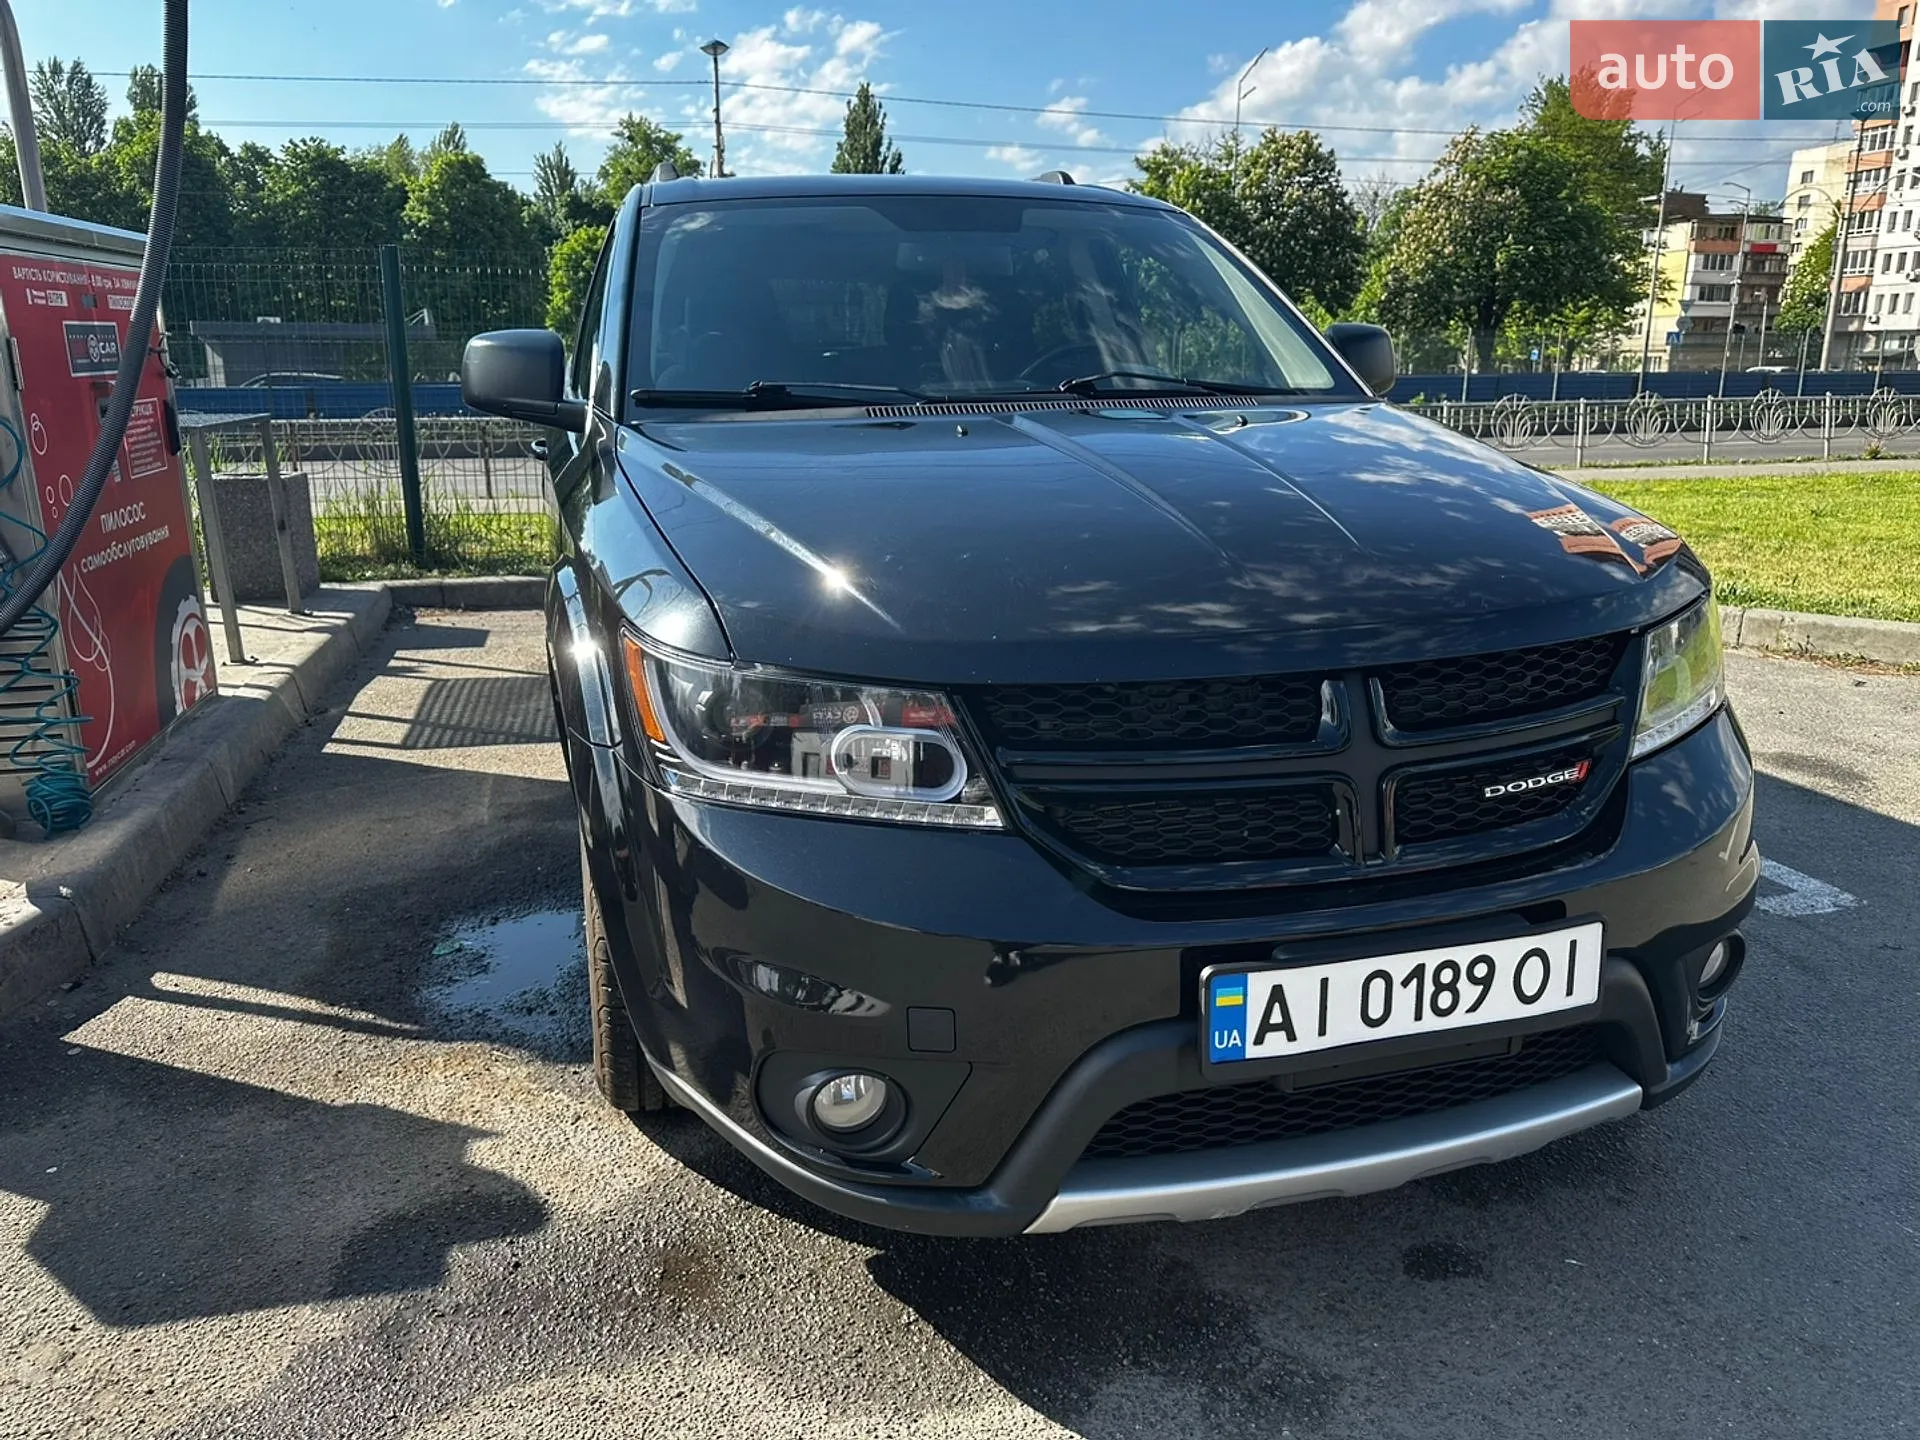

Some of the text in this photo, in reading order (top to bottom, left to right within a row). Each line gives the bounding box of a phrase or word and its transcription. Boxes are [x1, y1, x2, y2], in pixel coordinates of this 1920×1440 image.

[99, 341, 117, 354] CAR
[101, 502, 146, 534] ПИЛОСОС
[81, 525, 169, 573] самообслуговування
[1484, 767, 1580, 797] DODGE
[1360, 954, 1496, 1028] 0189
[1214, 1030, 1242, 1049] UA
